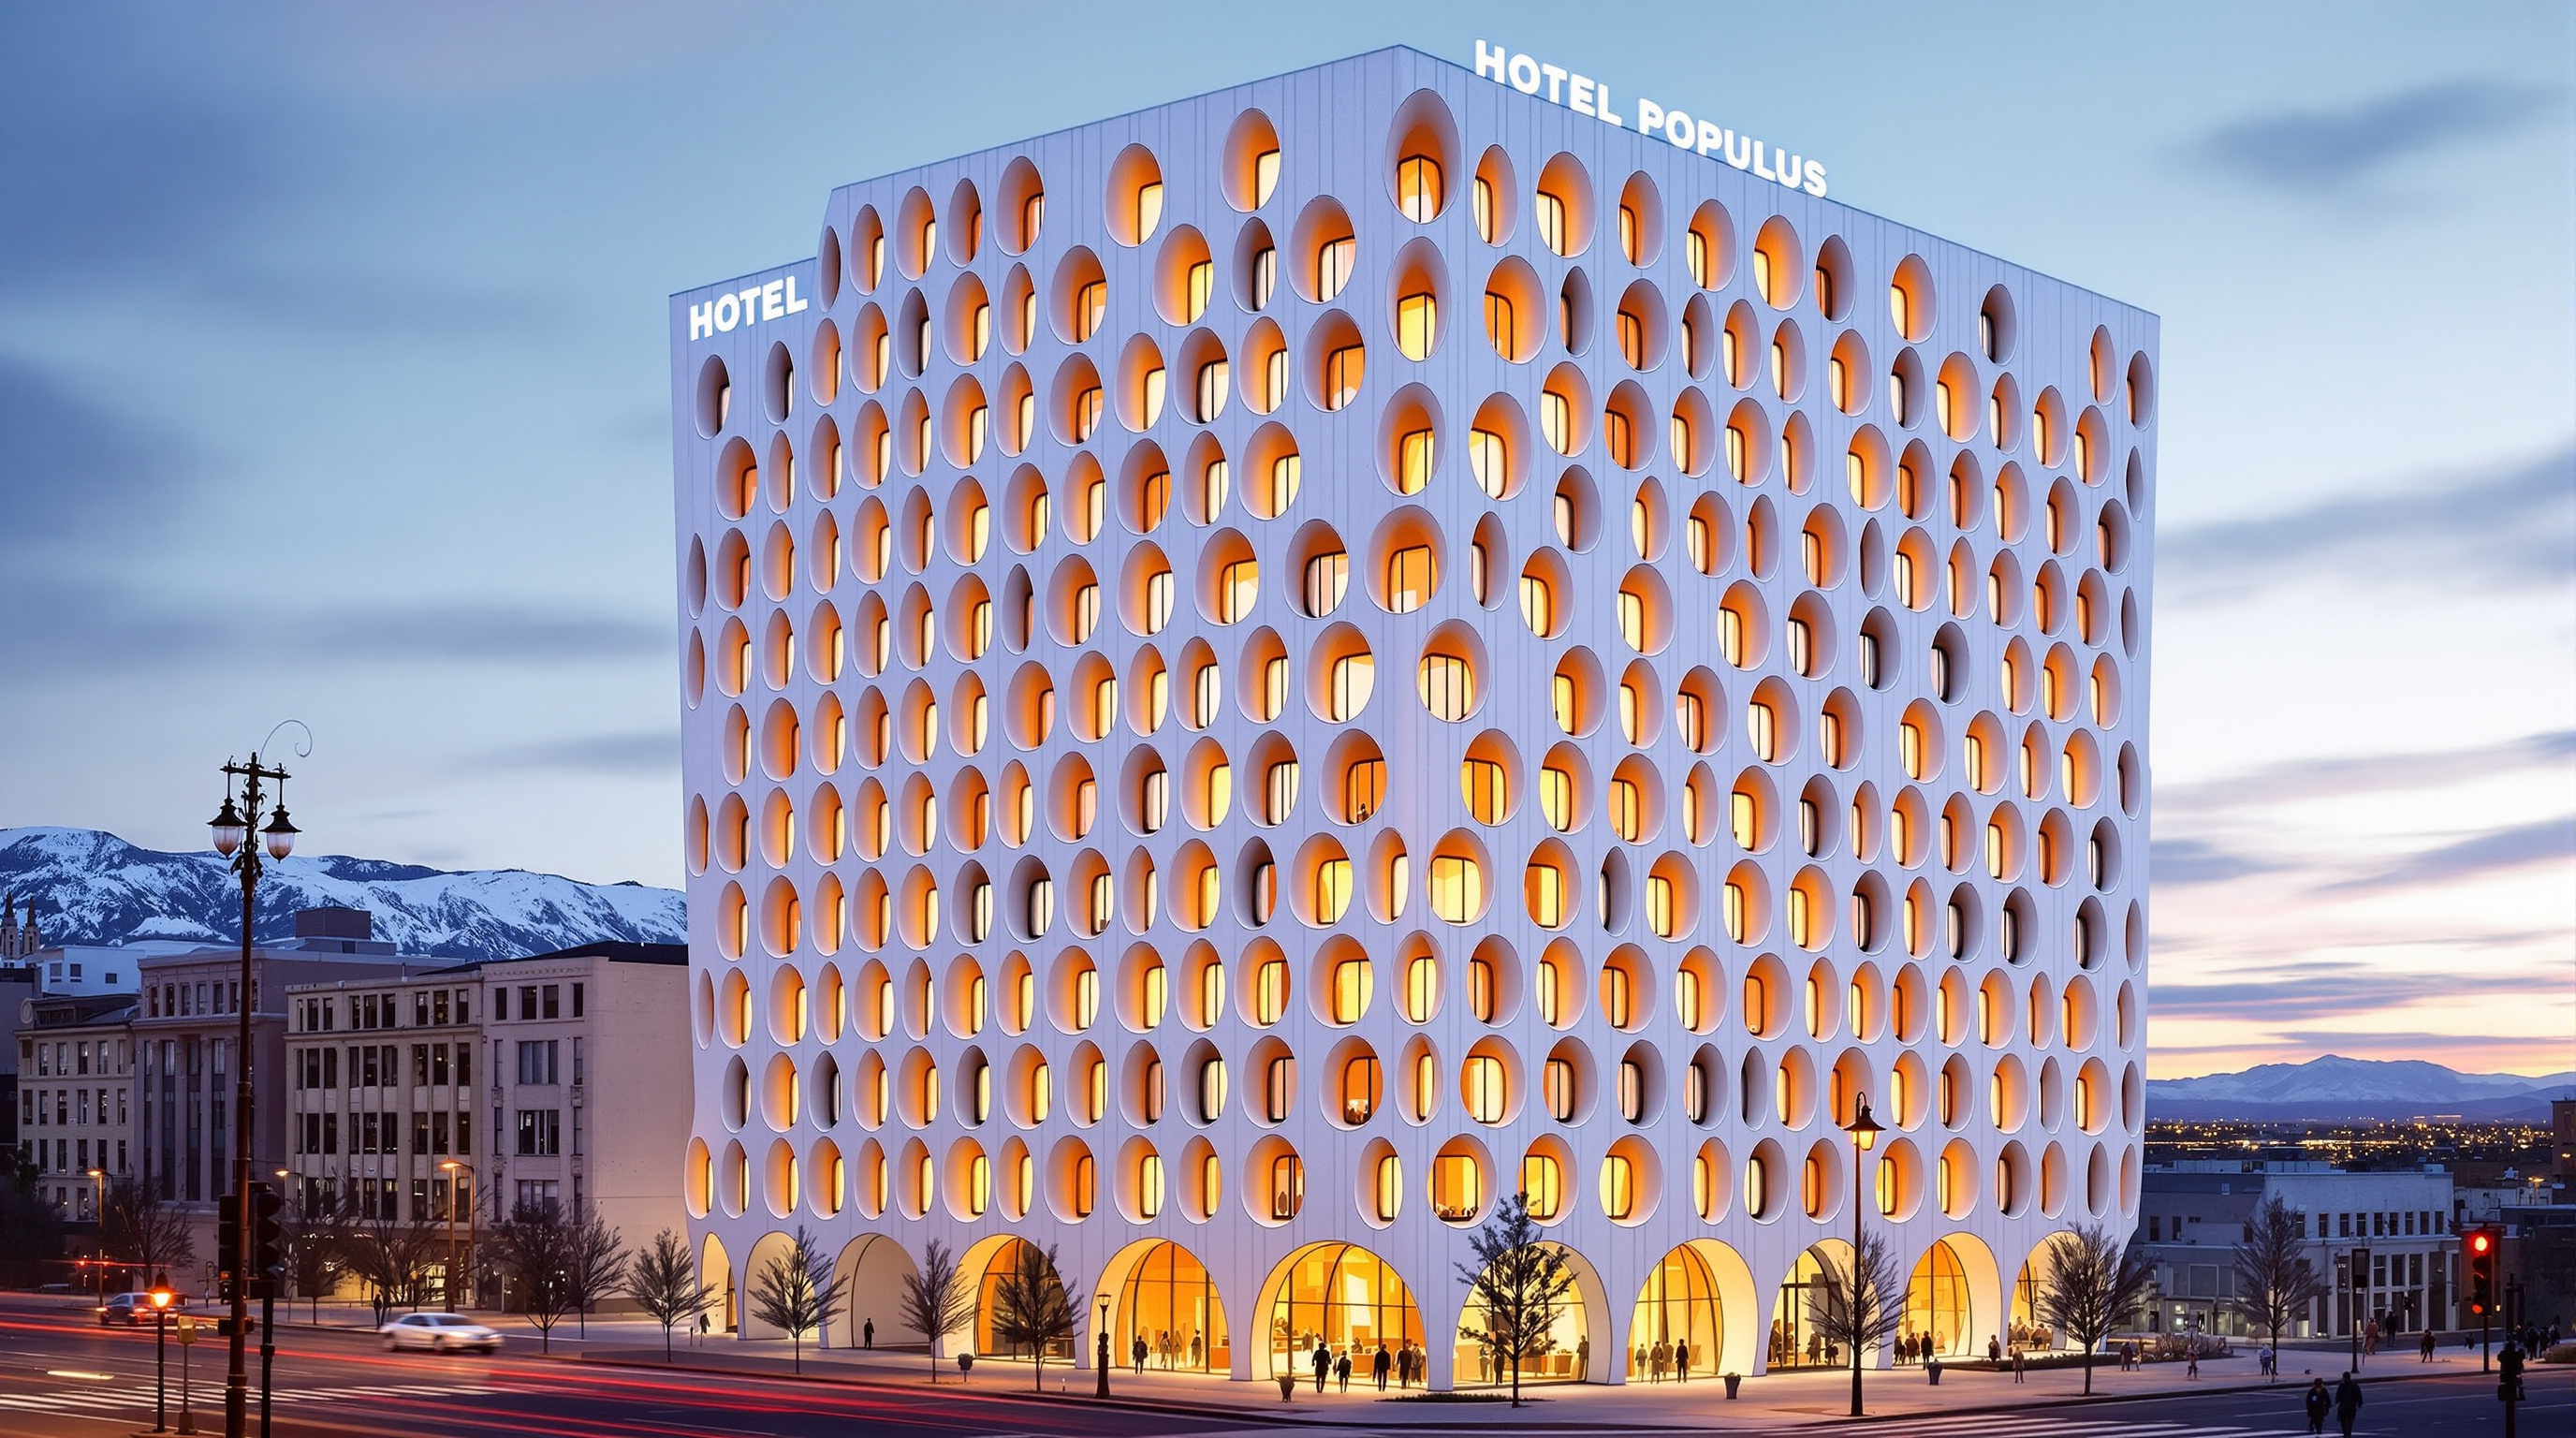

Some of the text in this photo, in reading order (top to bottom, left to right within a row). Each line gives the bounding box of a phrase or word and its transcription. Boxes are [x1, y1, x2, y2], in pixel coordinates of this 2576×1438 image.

[1475, 39, 1827, 198] HOTEL POPULUS
[690, 276, 808, 341] HOTEL
